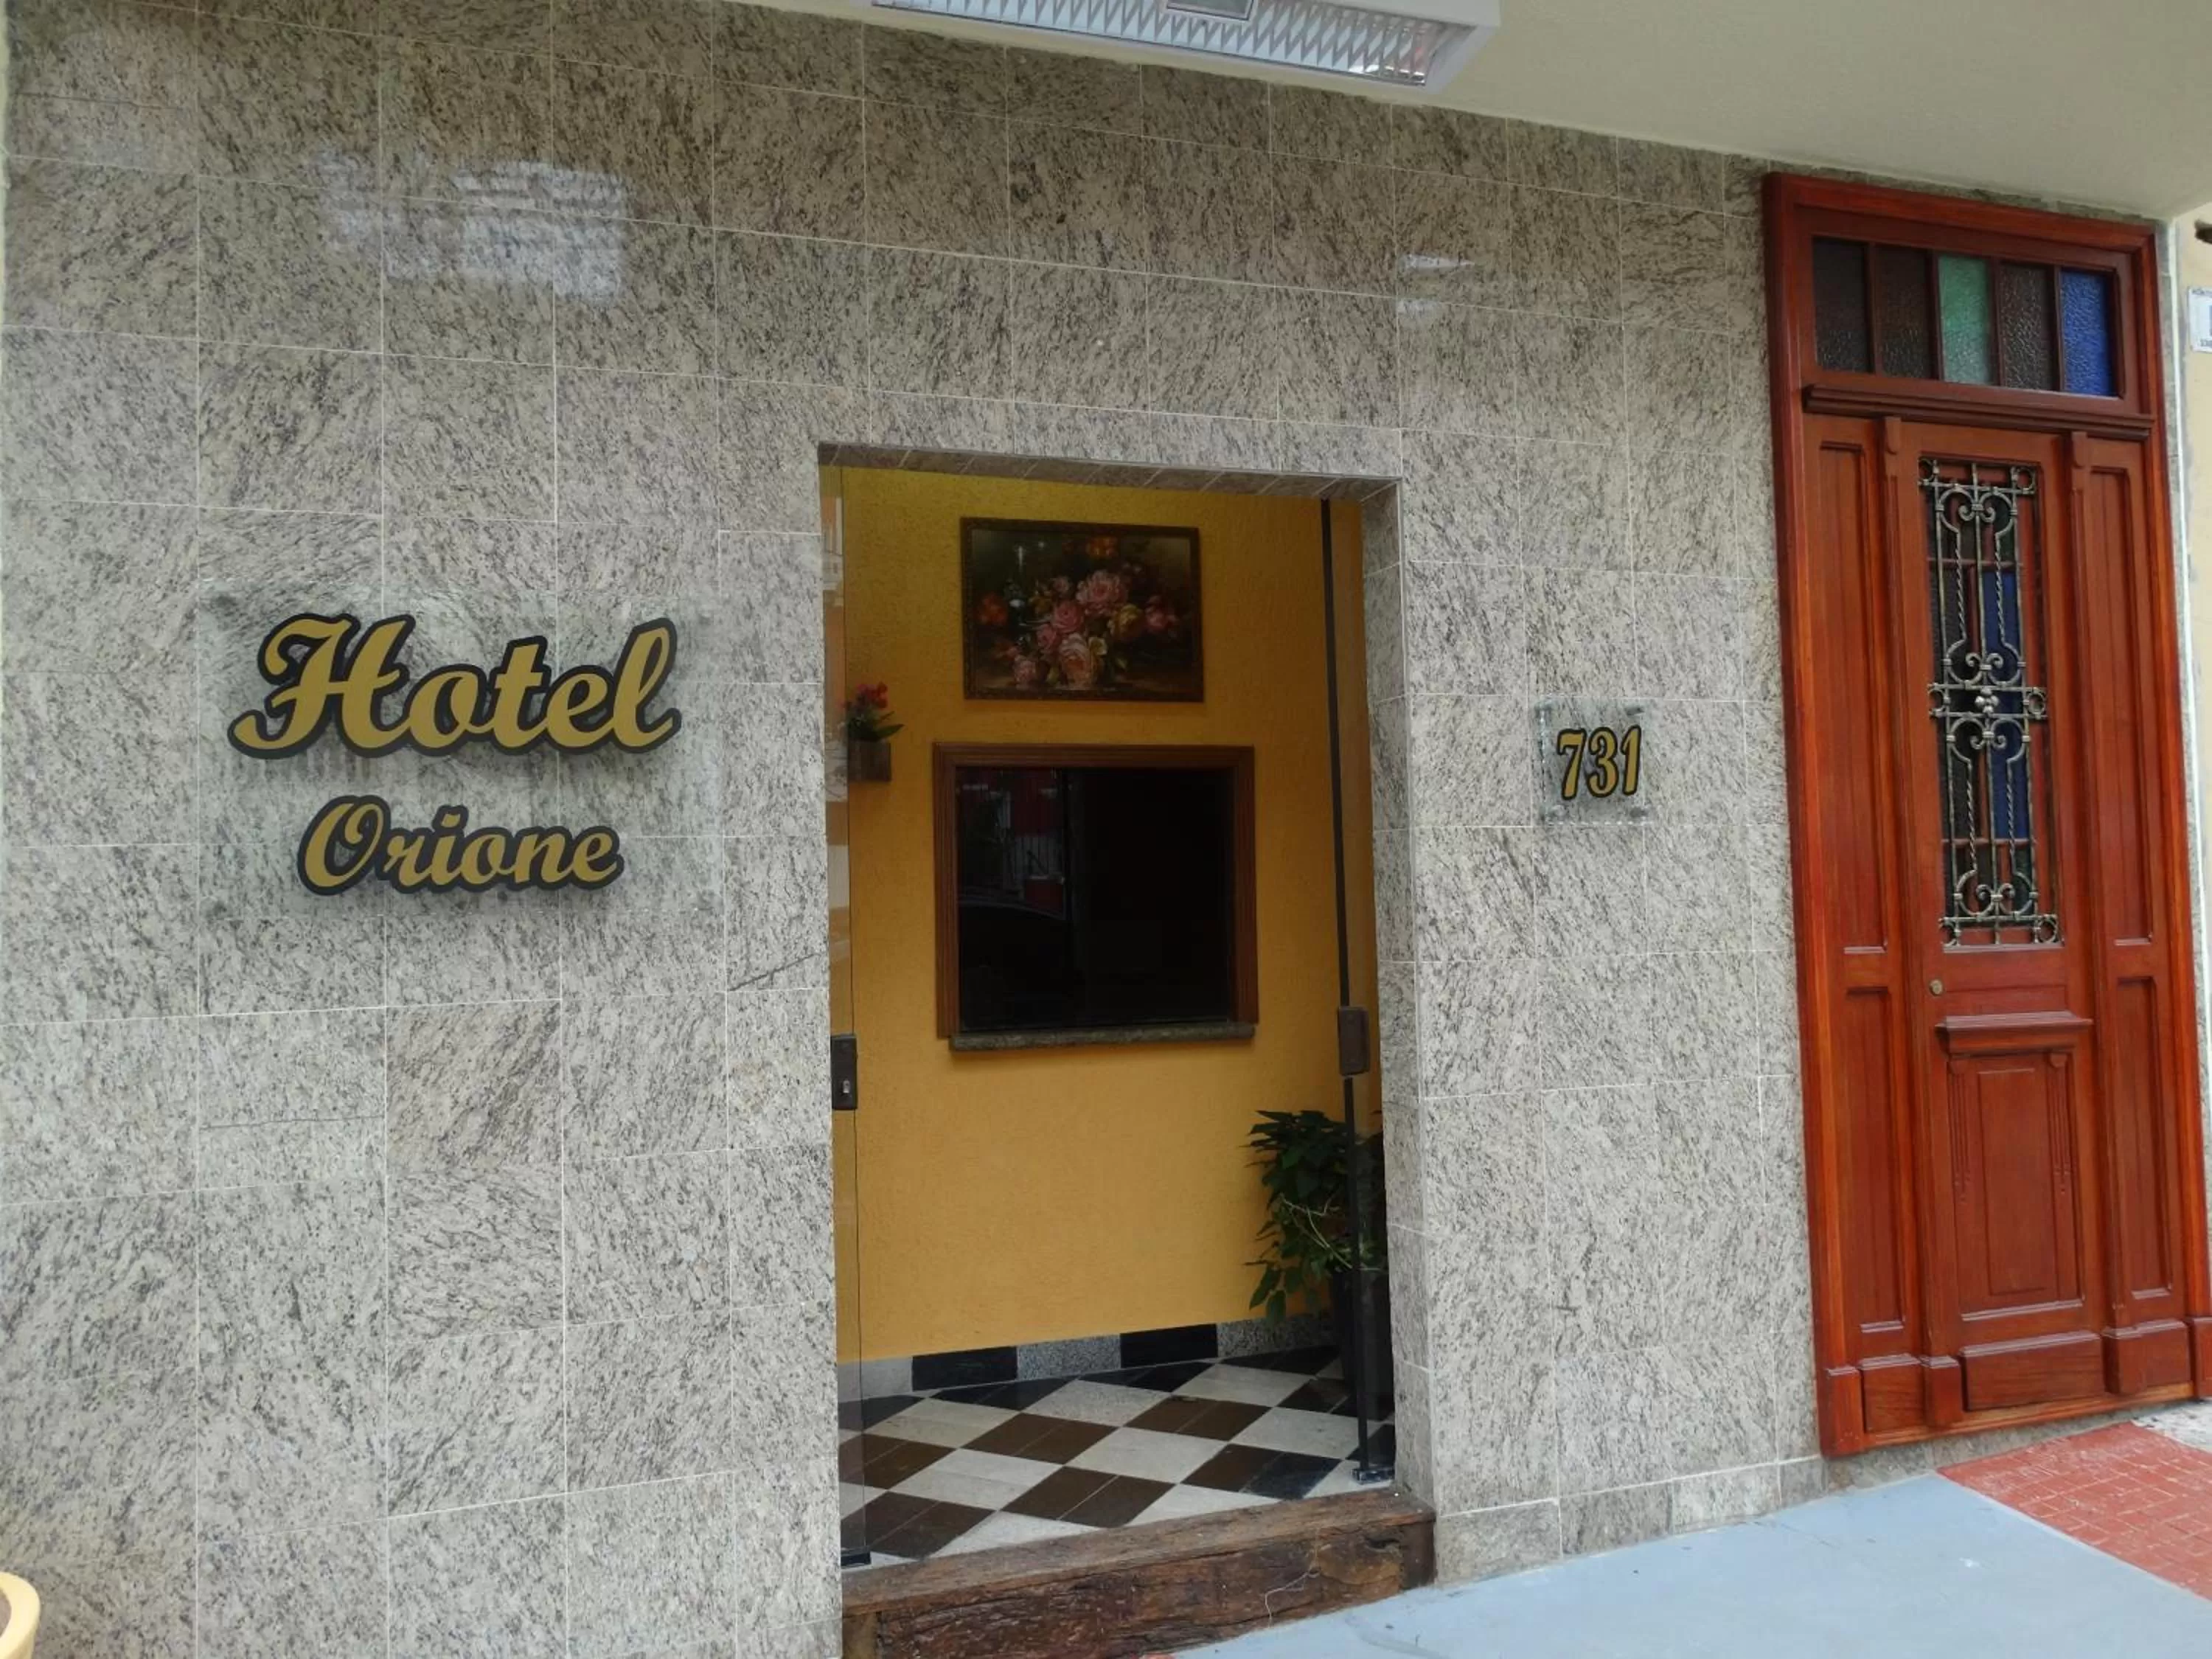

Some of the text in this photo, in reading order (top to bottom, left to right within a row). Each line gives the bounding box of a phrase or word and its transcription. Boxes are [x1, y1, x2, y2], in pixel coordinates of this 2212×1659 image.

[228, 613, 681, 759] Hotel
[1557, 725, 1642, 800] 731
[298, 795, 624, 895] Orione
